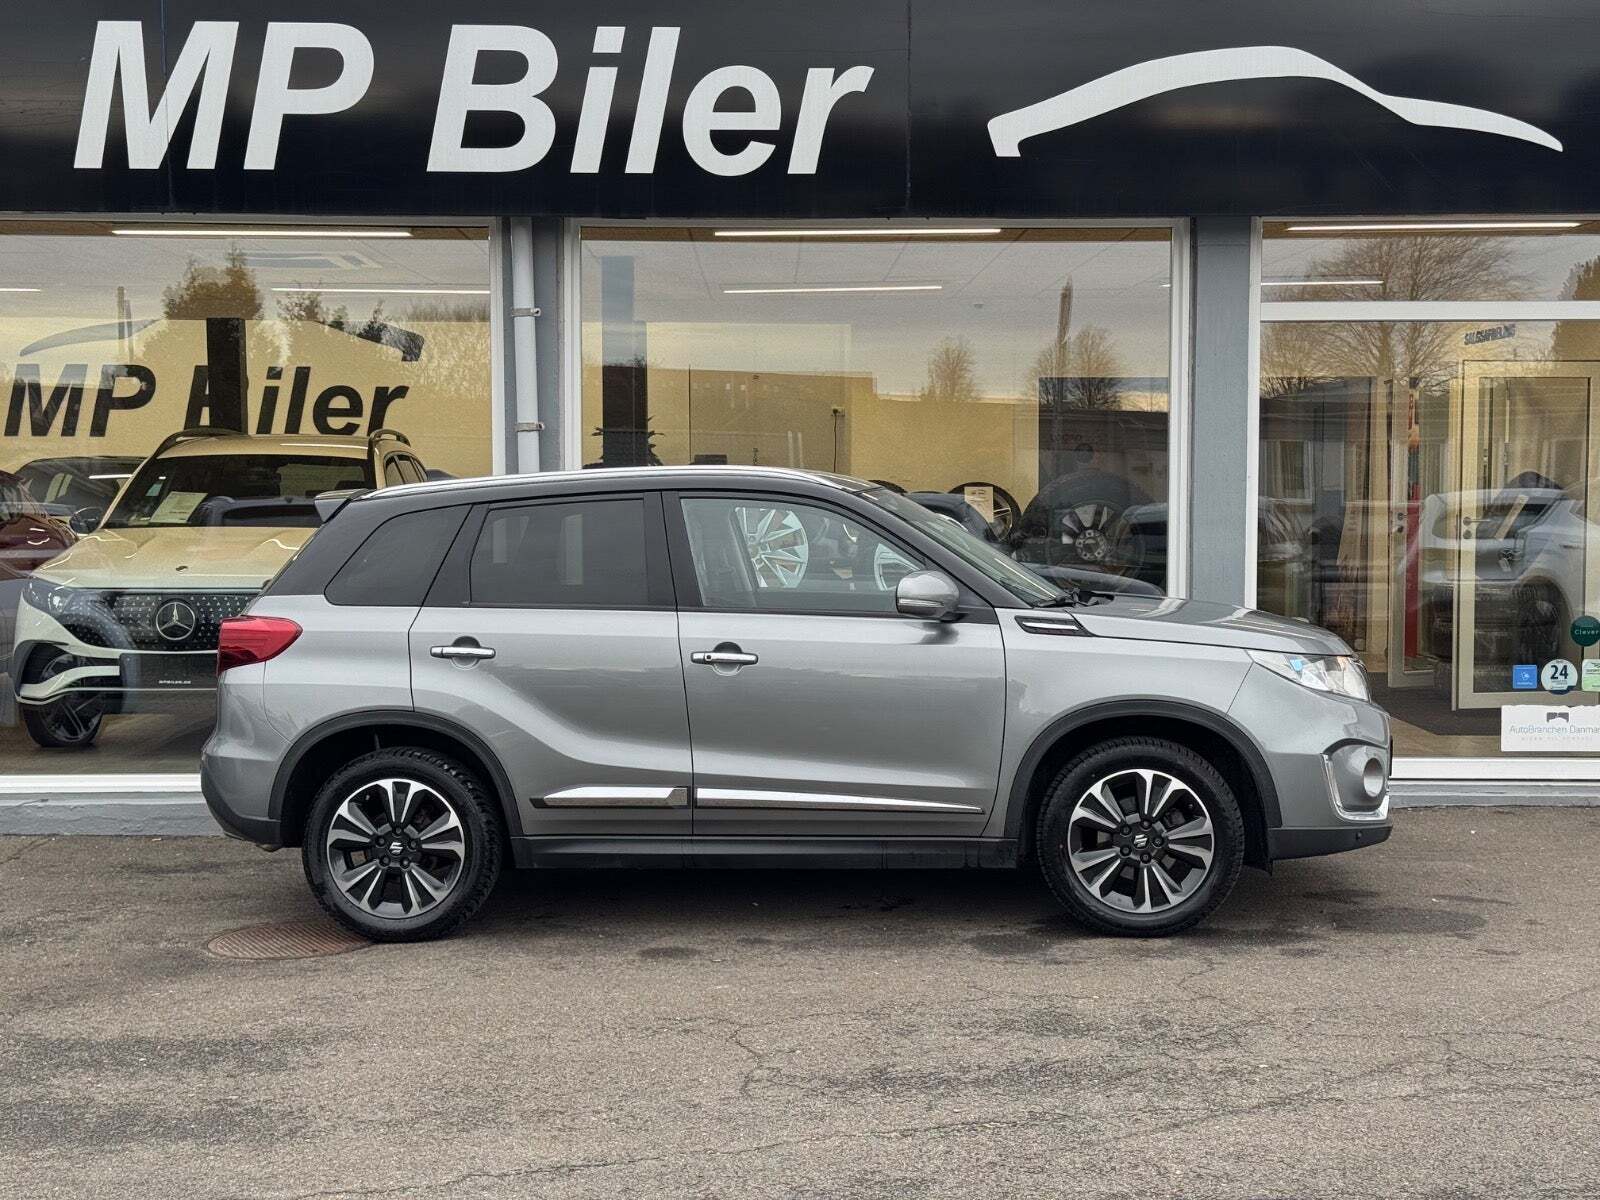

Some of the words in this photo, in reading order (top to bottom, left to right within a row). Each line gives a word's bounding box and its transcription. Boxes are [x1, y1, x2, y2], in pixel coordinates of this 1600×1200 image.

[73, 20, 375, 170] MP
[426, 24, 875, 177] Biler
[4, 363, 156, 438] MP
[1550, 665, 1568, 679] 24
[1510, 725, 1567, 734] AutoBranchen
[1569, 725, 1600, 734] Danmar
